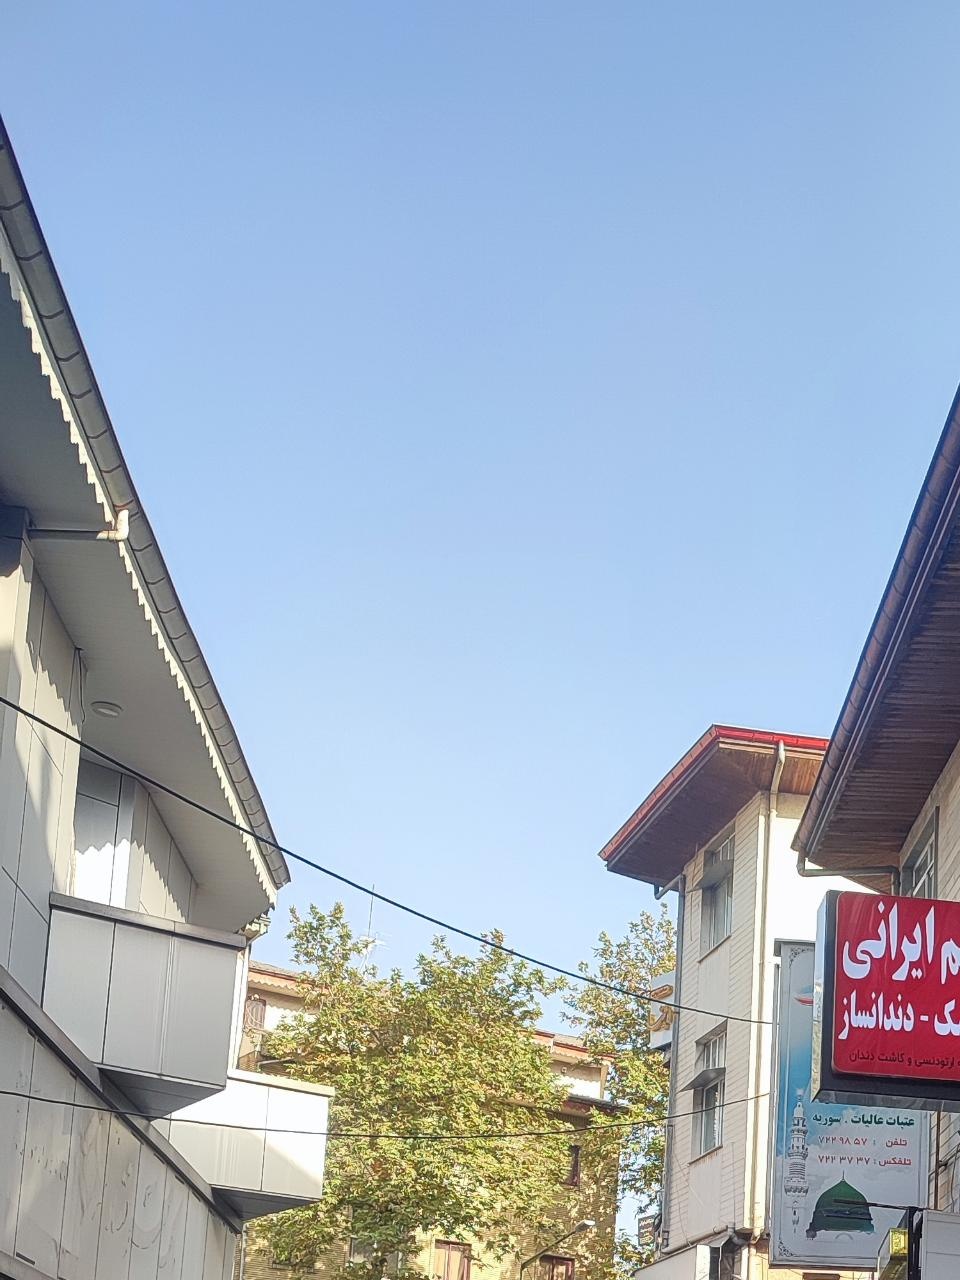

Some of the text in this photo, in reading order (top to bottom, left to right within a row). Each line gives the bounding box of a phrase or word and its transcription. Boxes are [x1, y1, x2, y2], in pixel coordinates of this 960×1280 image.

[842, 901, 936, 982] ایرانی
[837, 989, 915, 1040] دندانساز
[849, 1051, 875, 1062] دندان
[886, 1115, 915, 1130] عتبات
[885, 1138, 908, 1148] تلفن
